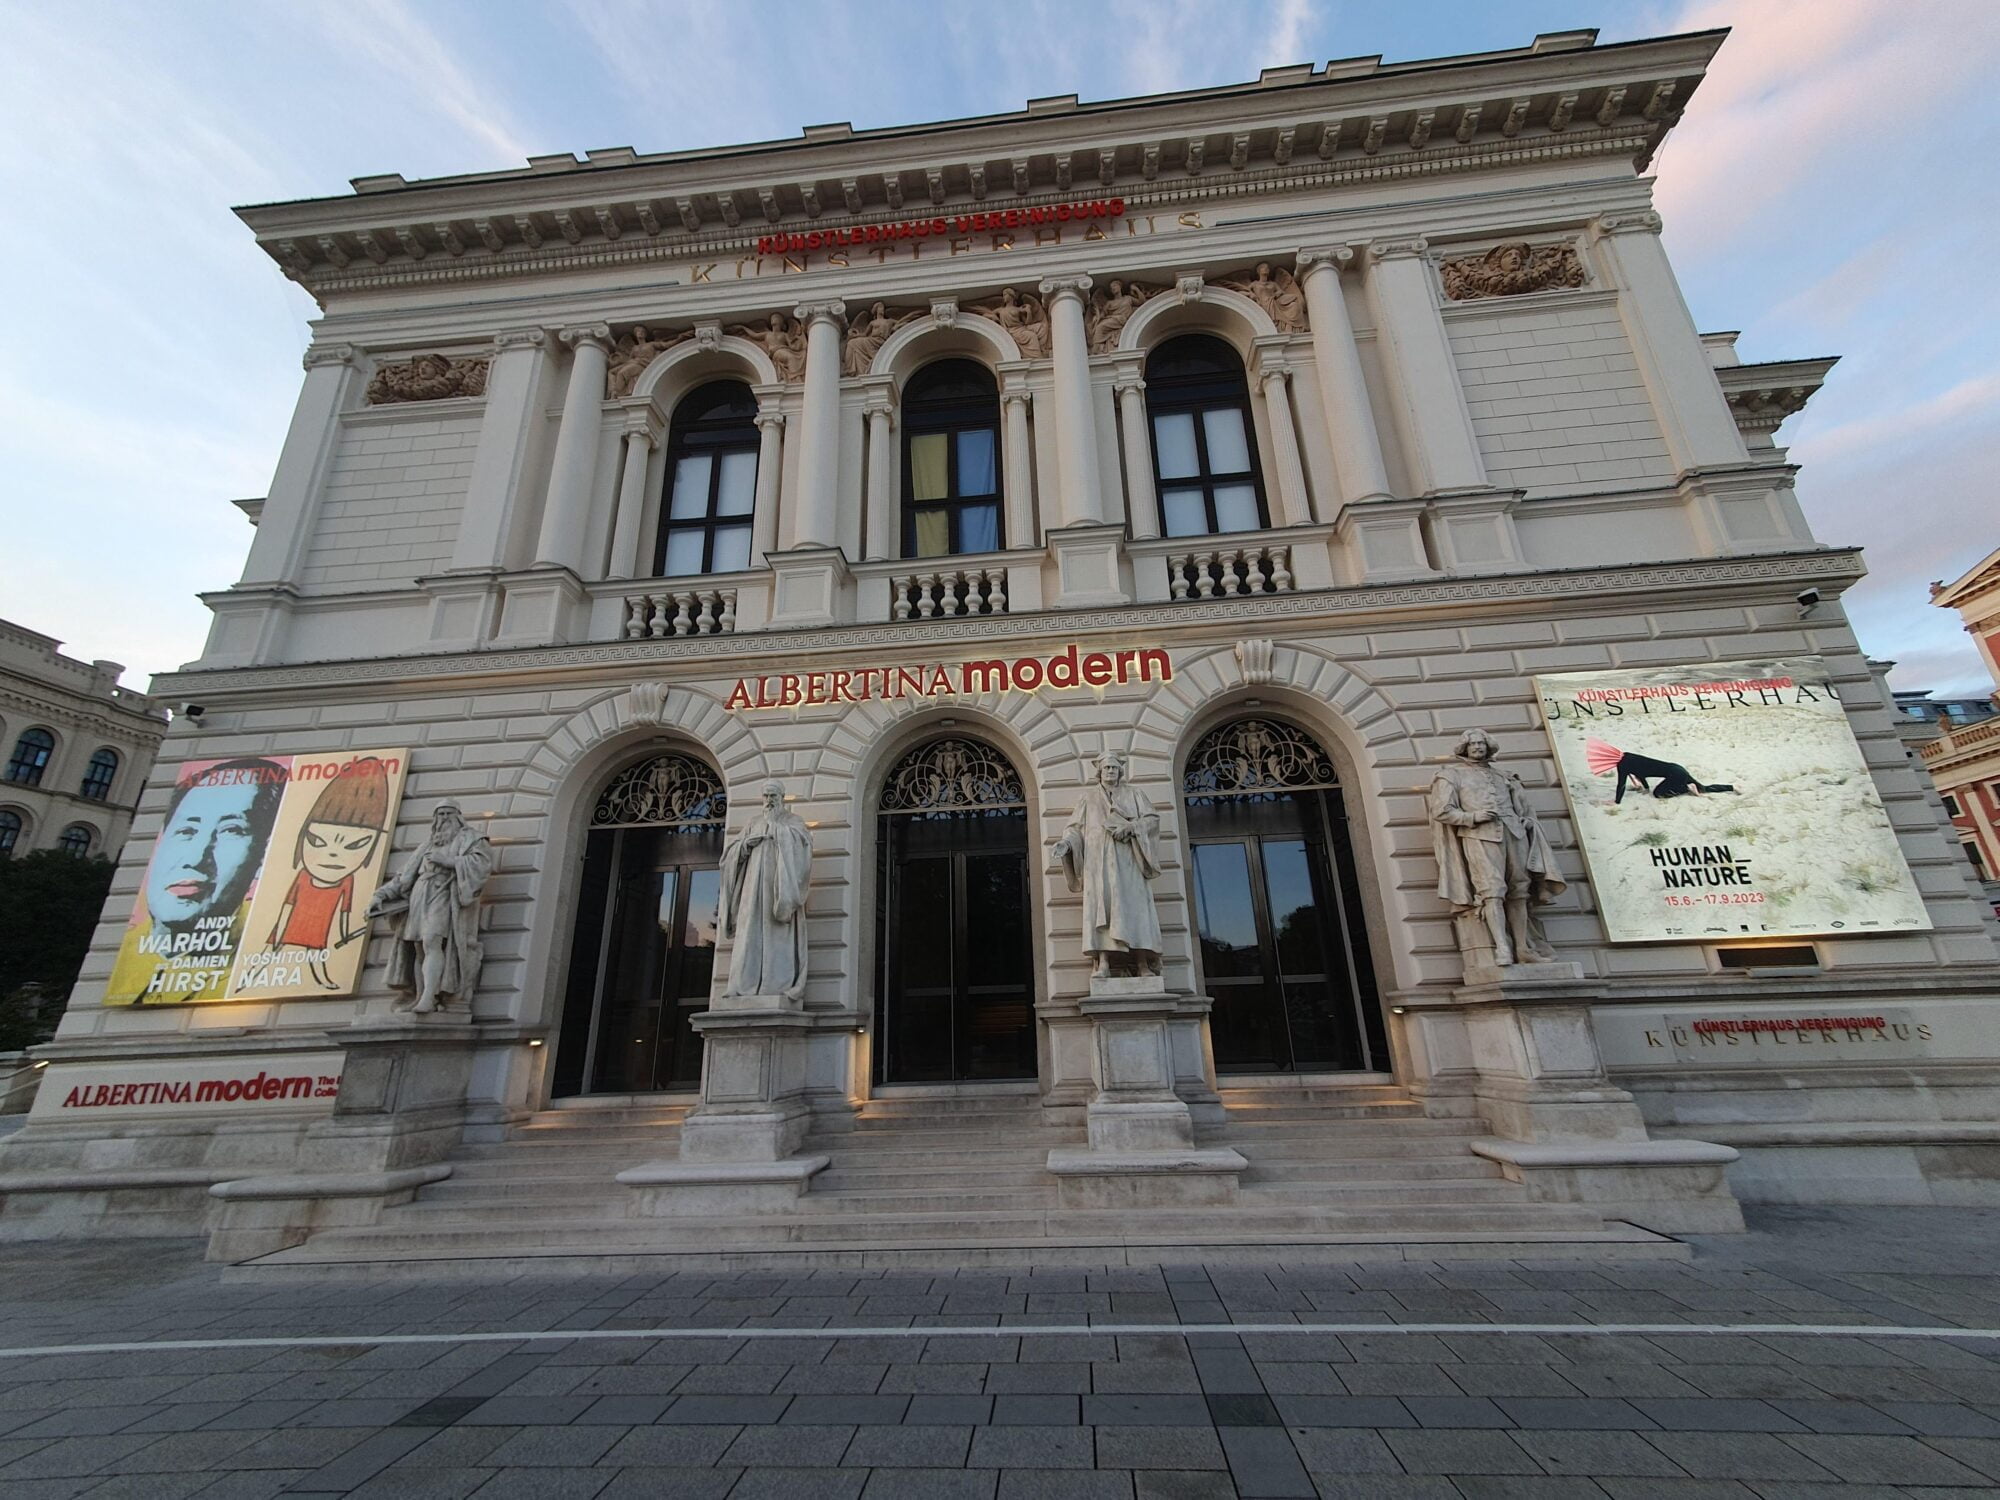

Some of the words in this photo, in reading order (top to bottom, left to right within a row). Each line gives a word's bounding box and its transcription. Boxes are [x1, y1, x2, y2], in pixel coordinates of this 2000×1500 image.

[758, 215, 947, 255] KÜNSTLERHAUS
[955, 196, 1125, 233] VEREINIGUNG
[724, 665, 955, 710] ALBERTINA
[962, 644, 1172, 694] modern
[1577, 683, 1689, 702] KÜNSTLERHAUS
[1692, 676, 1792, 695] VEREINIGUNG
[181, 764, 293, 788] ALBERTINA
[298, 755, 399, 781] modern
[1662, 866, 1752, 888] NATURE
[195, 916, 236, 930] ANDY
[138, 931, 233, 954] WARHOL
[172, 955, 229, 969] DAMIEN
[242, 949, 330, 966] YOSHITOMO
[147, 970, 225, 993] HIRST
[237, 966, 302, 989] NARA
[1644, 1023, 1933, 1048] KÜNSTLERHAUS
[1692, 1018, 1793, 1034] KÜNSTLERHAUS
[1796, 1016, 1886, 1031] VEREINIGUNG
[62, 1081, 192, 1107] ALBERTINA
[195, 1072, 313, 1102] modern
[318, 1076, 335, 1085] The
